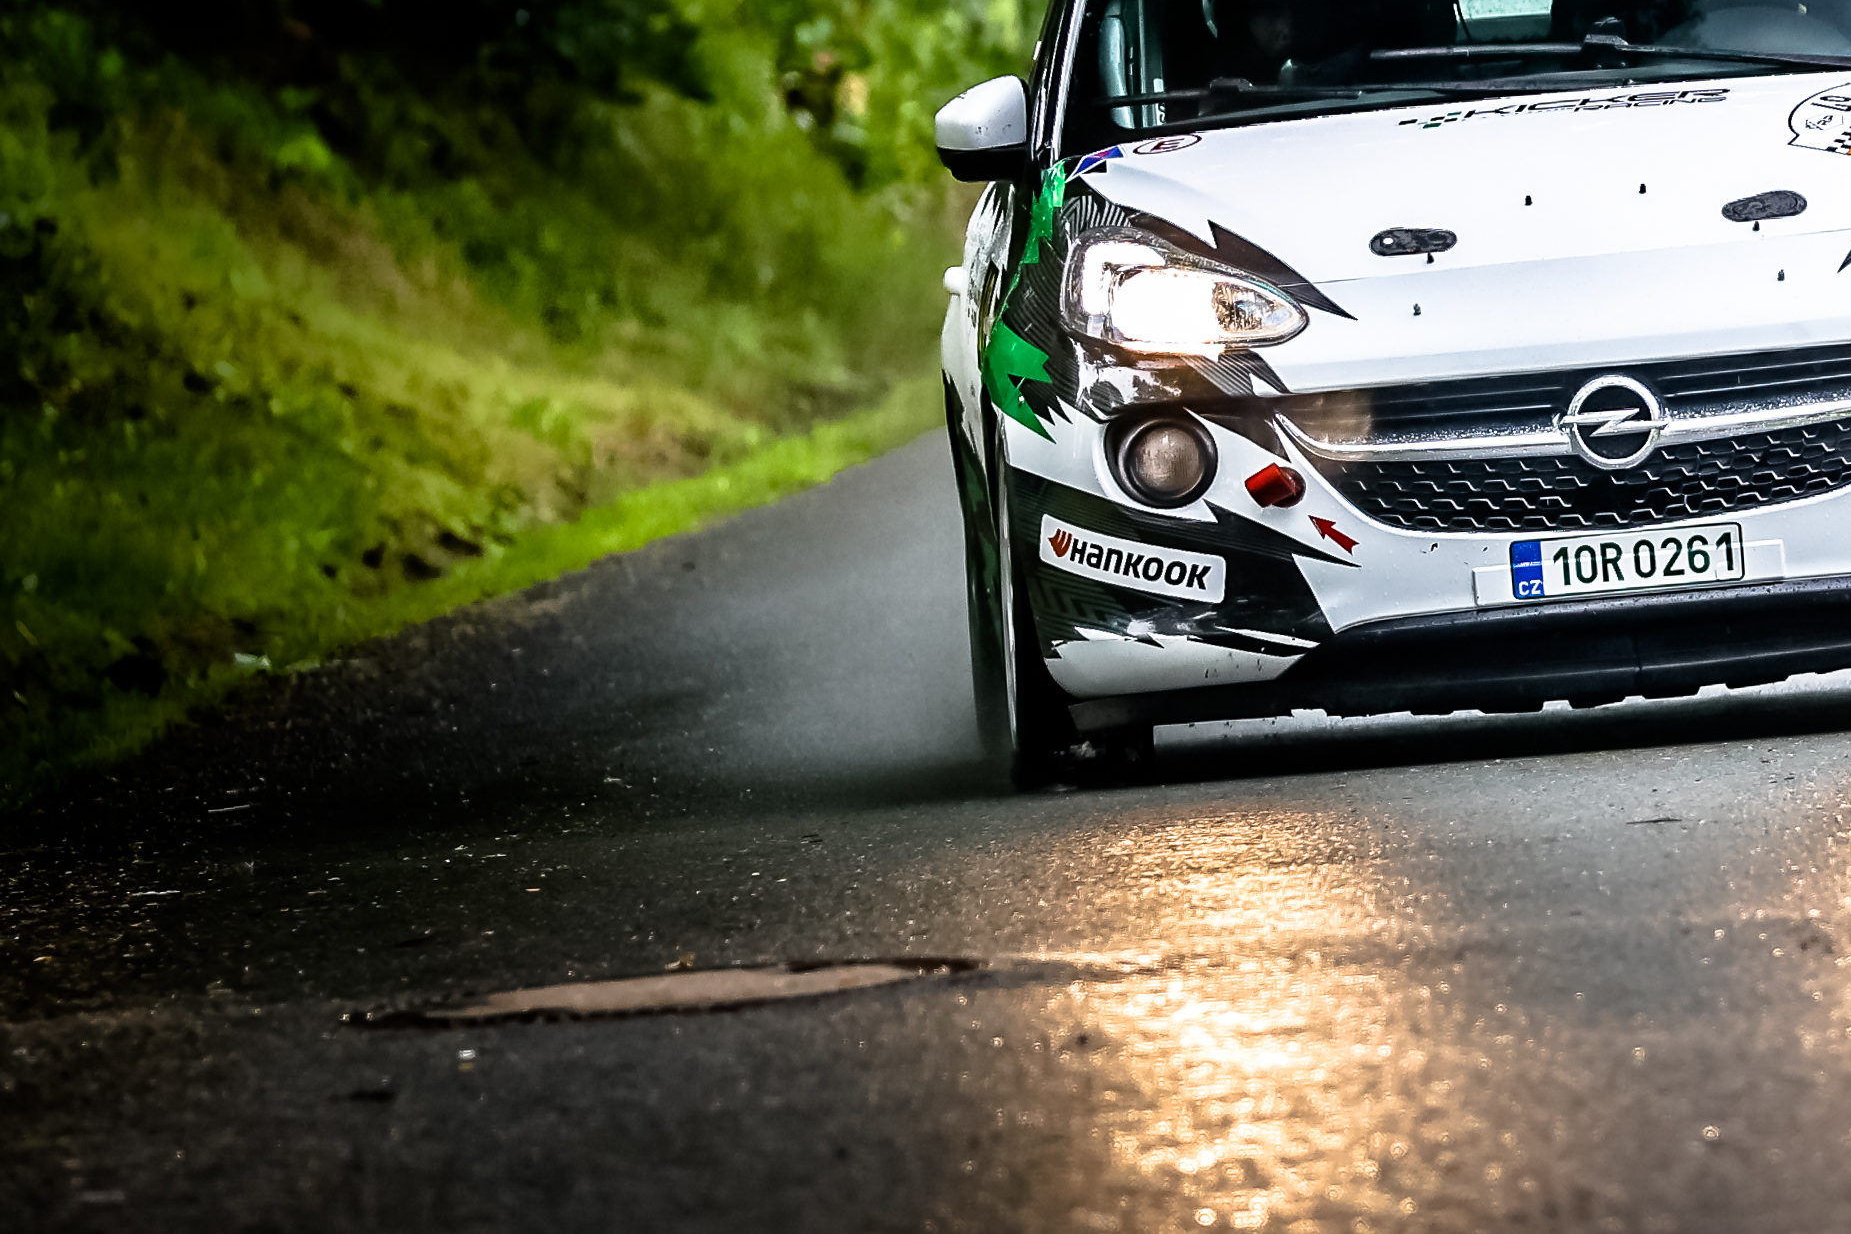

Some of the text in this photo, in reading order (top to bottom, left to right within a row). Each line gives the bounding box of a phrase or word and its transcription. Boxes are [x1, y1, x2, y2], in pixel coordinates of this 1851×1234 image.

[1463, 88, 1731, 118] KICKER
[1518, 532, 1735, 596] CZ 10R 0261
